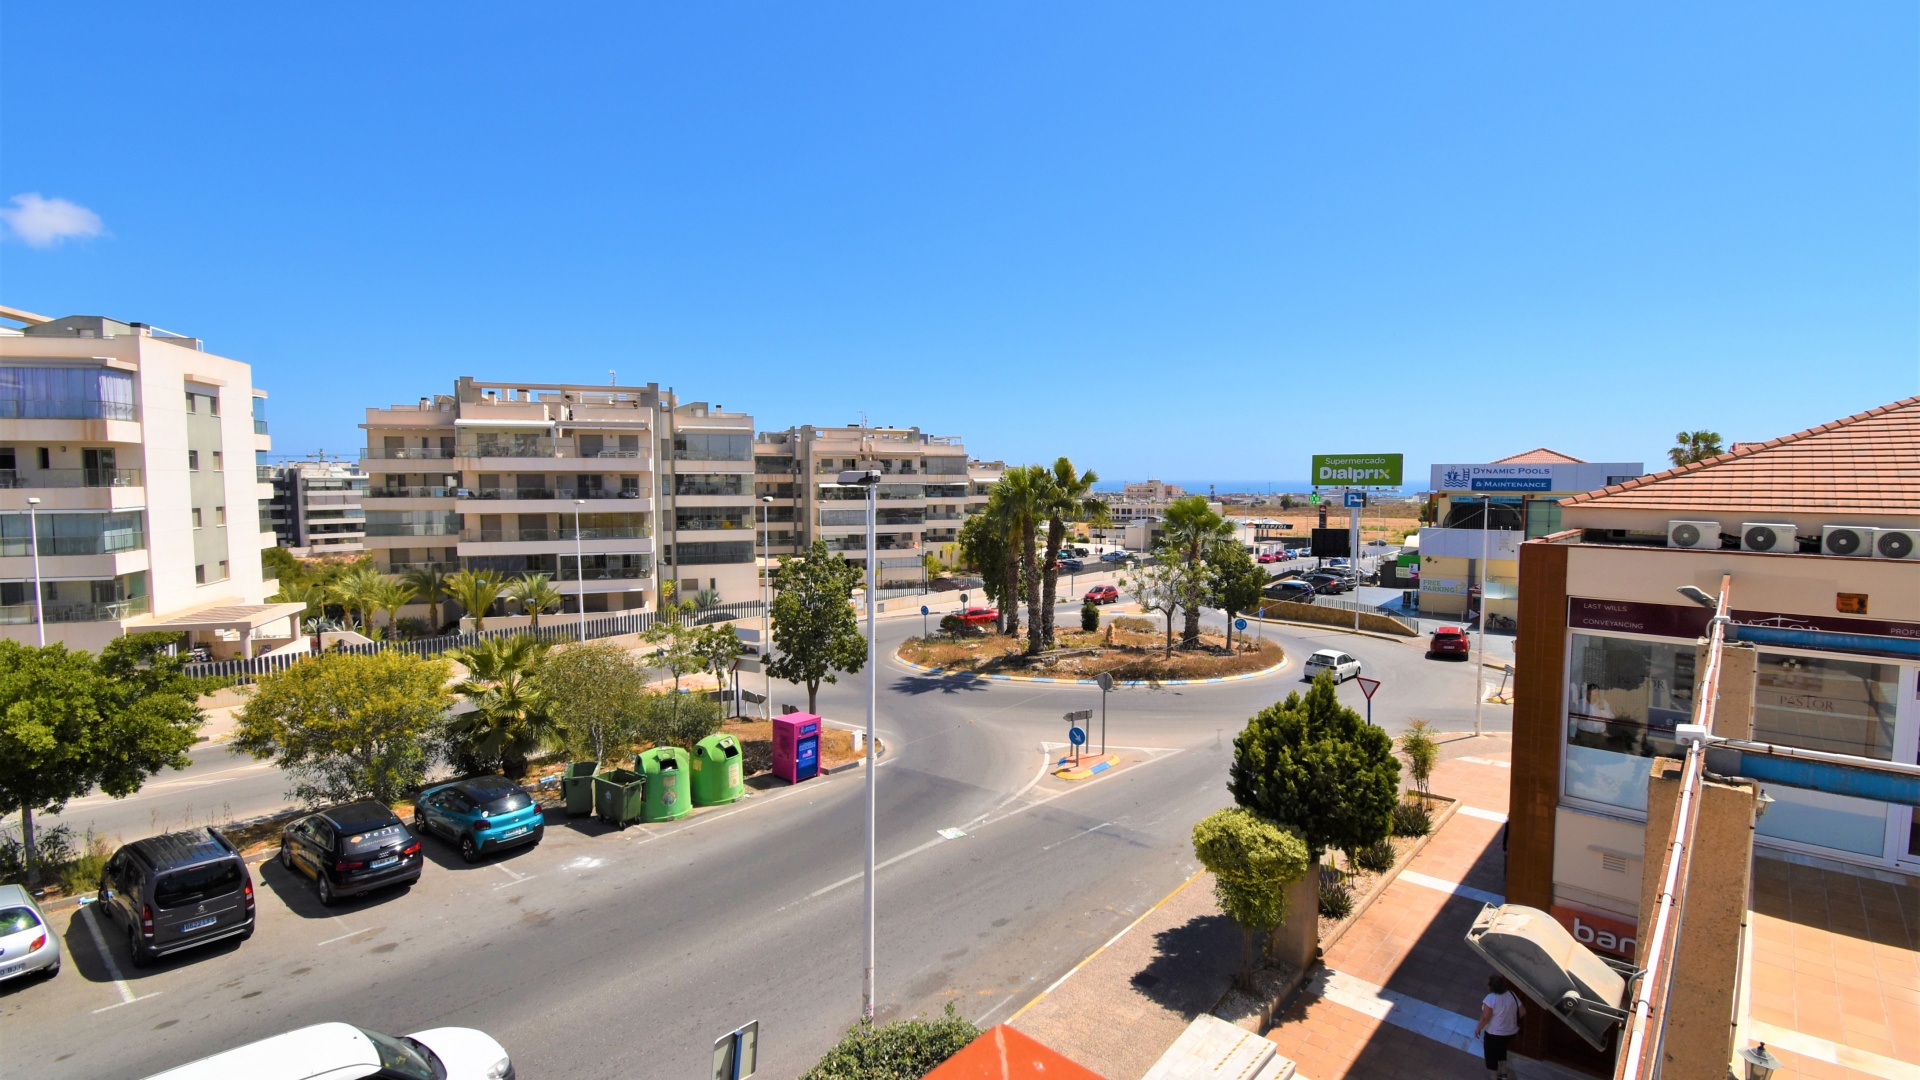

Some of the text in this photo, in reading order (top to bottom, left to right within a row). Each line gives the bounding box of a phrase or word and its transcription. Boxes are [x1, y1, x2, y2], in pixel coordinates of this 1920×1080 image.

[1325, 457, 1386, 466] Supermercado
[1319, 466, 1391, 483] Dialprix
[1473, 467, 1550, 475] DYNAMIC POOLS
[1422, 585, 1455, 593] PARKING
[1603, 604, 1628, 612] WILLS
[1582, 618, 1643, 629] CONVEYANCING
[1779, 695, 1834, 711] PASTOR
[364, 827, 400, 839] Perla
